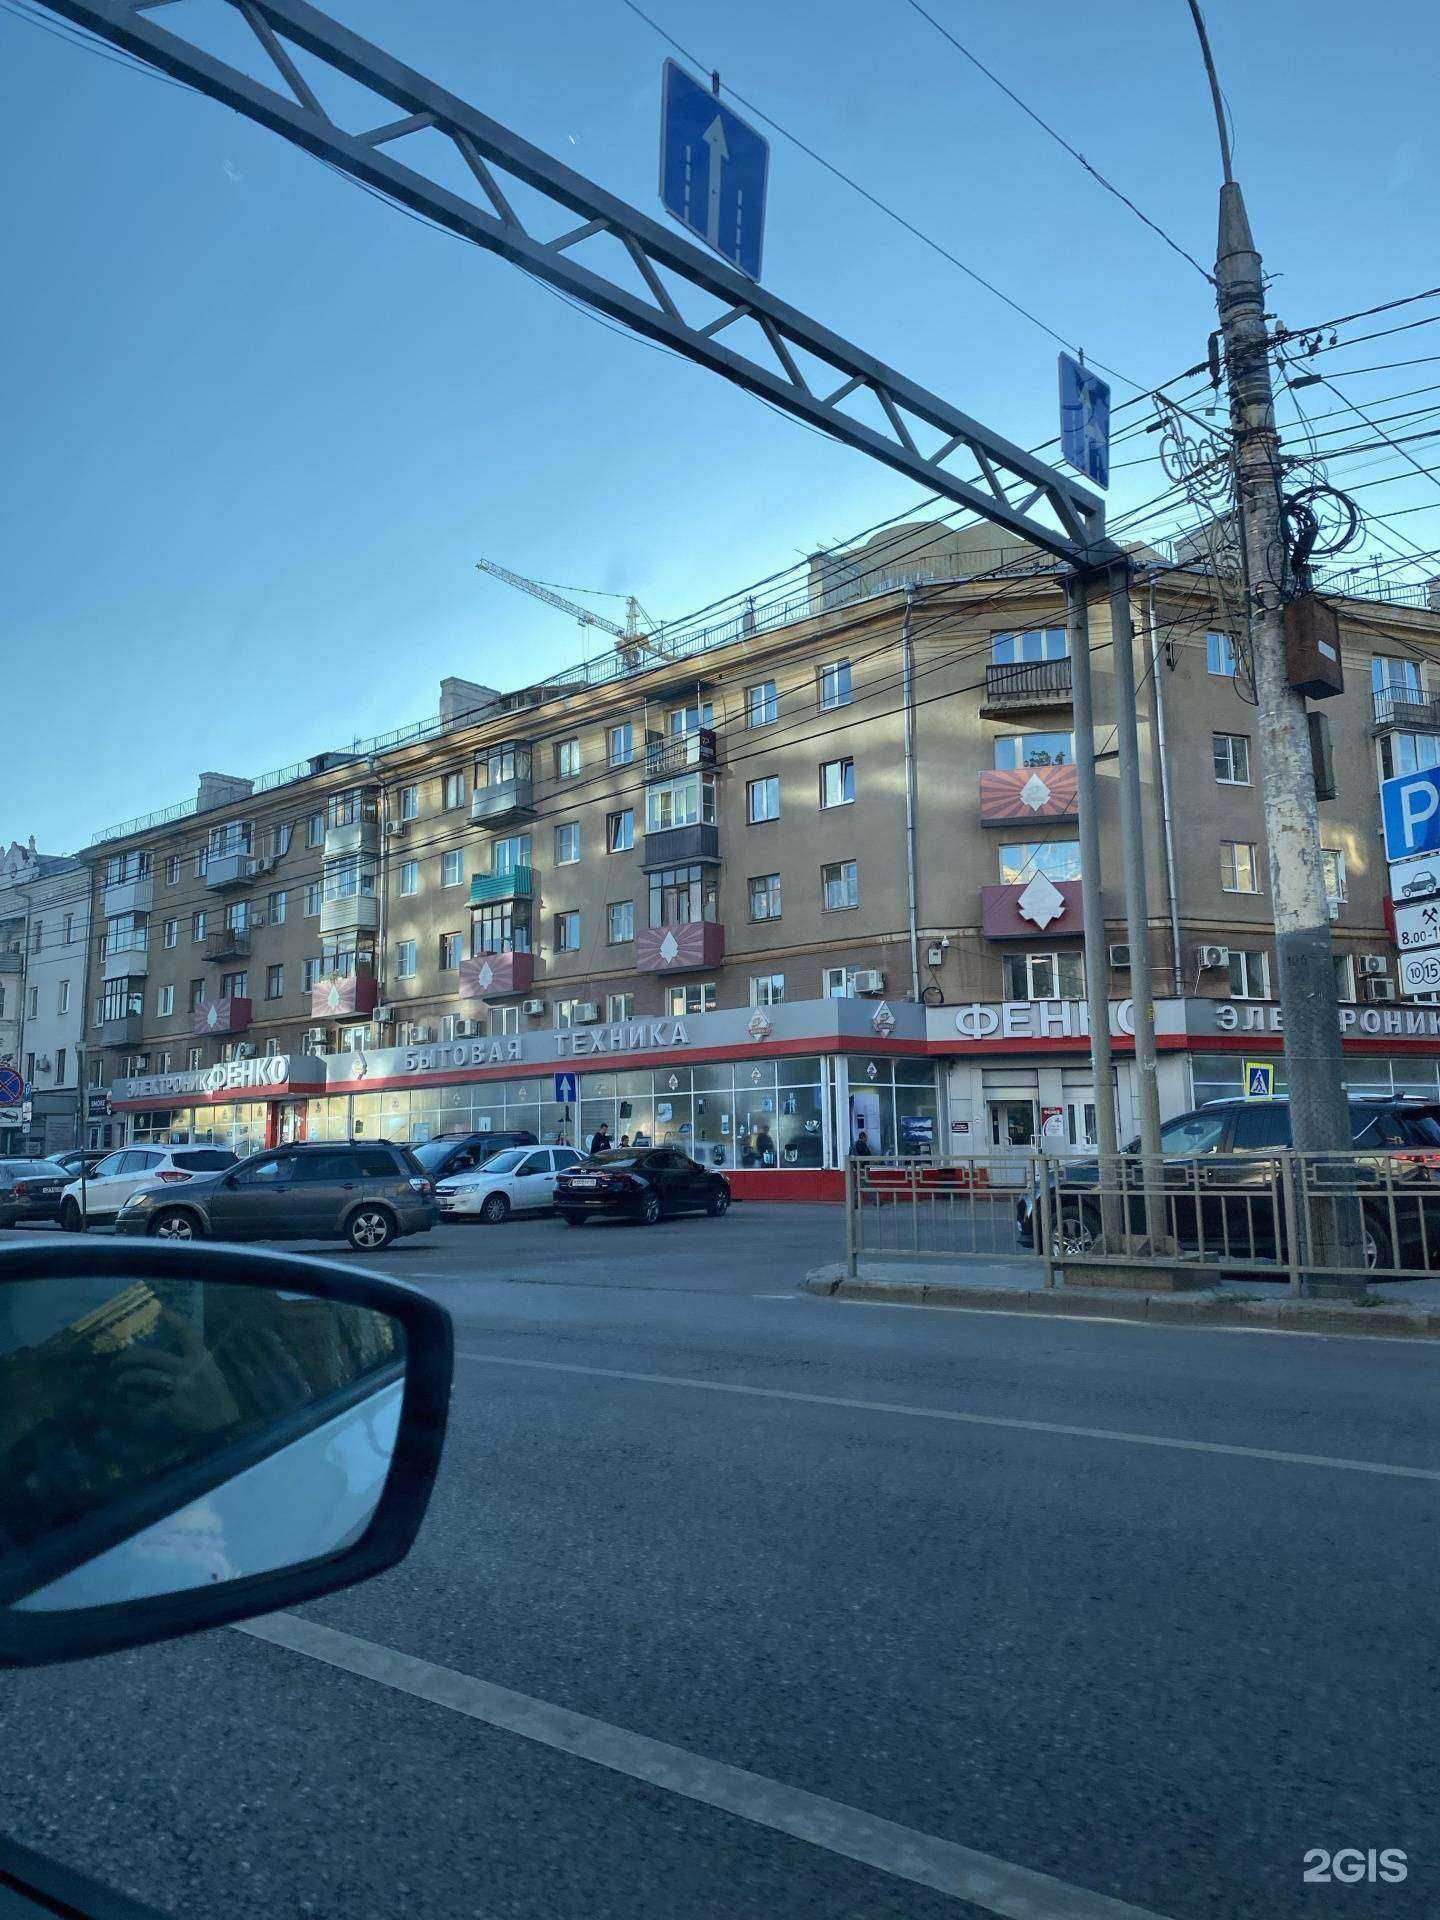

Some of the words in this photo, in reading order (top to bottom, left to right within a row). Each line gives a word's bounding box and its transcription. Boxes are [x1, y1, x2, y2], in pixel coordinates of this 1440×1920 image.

[1401, 781, 1439, 848] P
[1402, 926, 1440, 945] 8.00-1
[1410, 967, 1421, 979] 10
[1424, 963, 1438, 978] 15
[1216, 1005, 1440, 1035] ЭЛЕРОНИК
[404, 1037, 523, 1072] БЫТОВАЯ
[553, 1020, 690, 1056] ТЕХНИКА
[127, 1072, 210, 1098] ЭЛЕКТРОНИК
[207, 1055, 290, 1092] ФЕНКО
